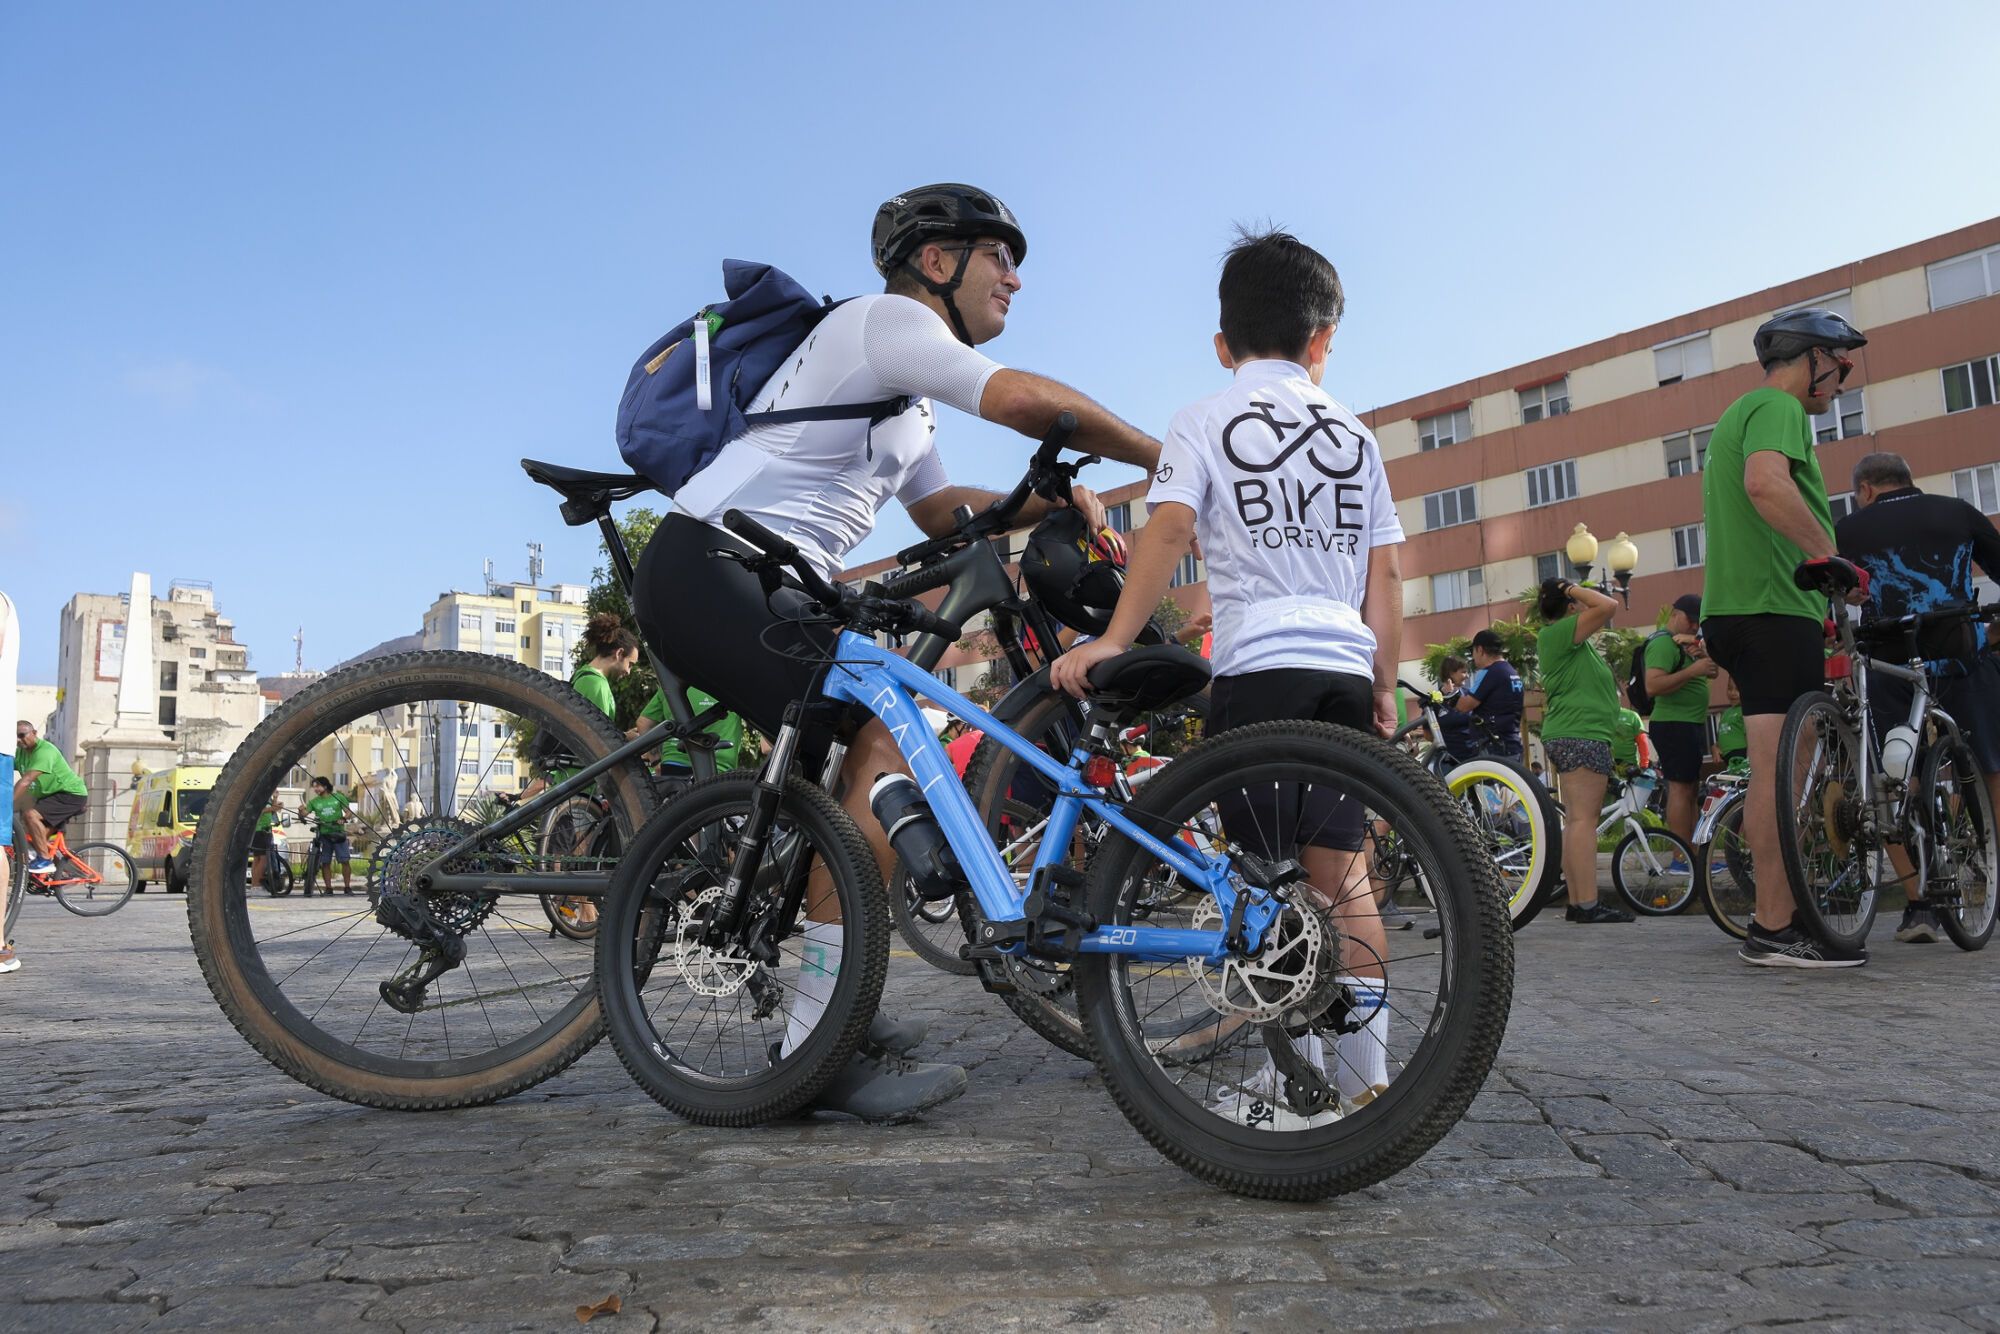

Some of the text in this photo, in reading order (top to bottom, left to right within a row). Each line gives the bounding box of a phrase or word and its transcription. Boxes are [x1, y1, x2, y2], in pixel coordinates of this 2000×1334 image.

[1233, 478, 1364, 531] BIKE
[1249, 526, 1359, 556] FOREVER
[1110, 929, 1137, 945] 20
